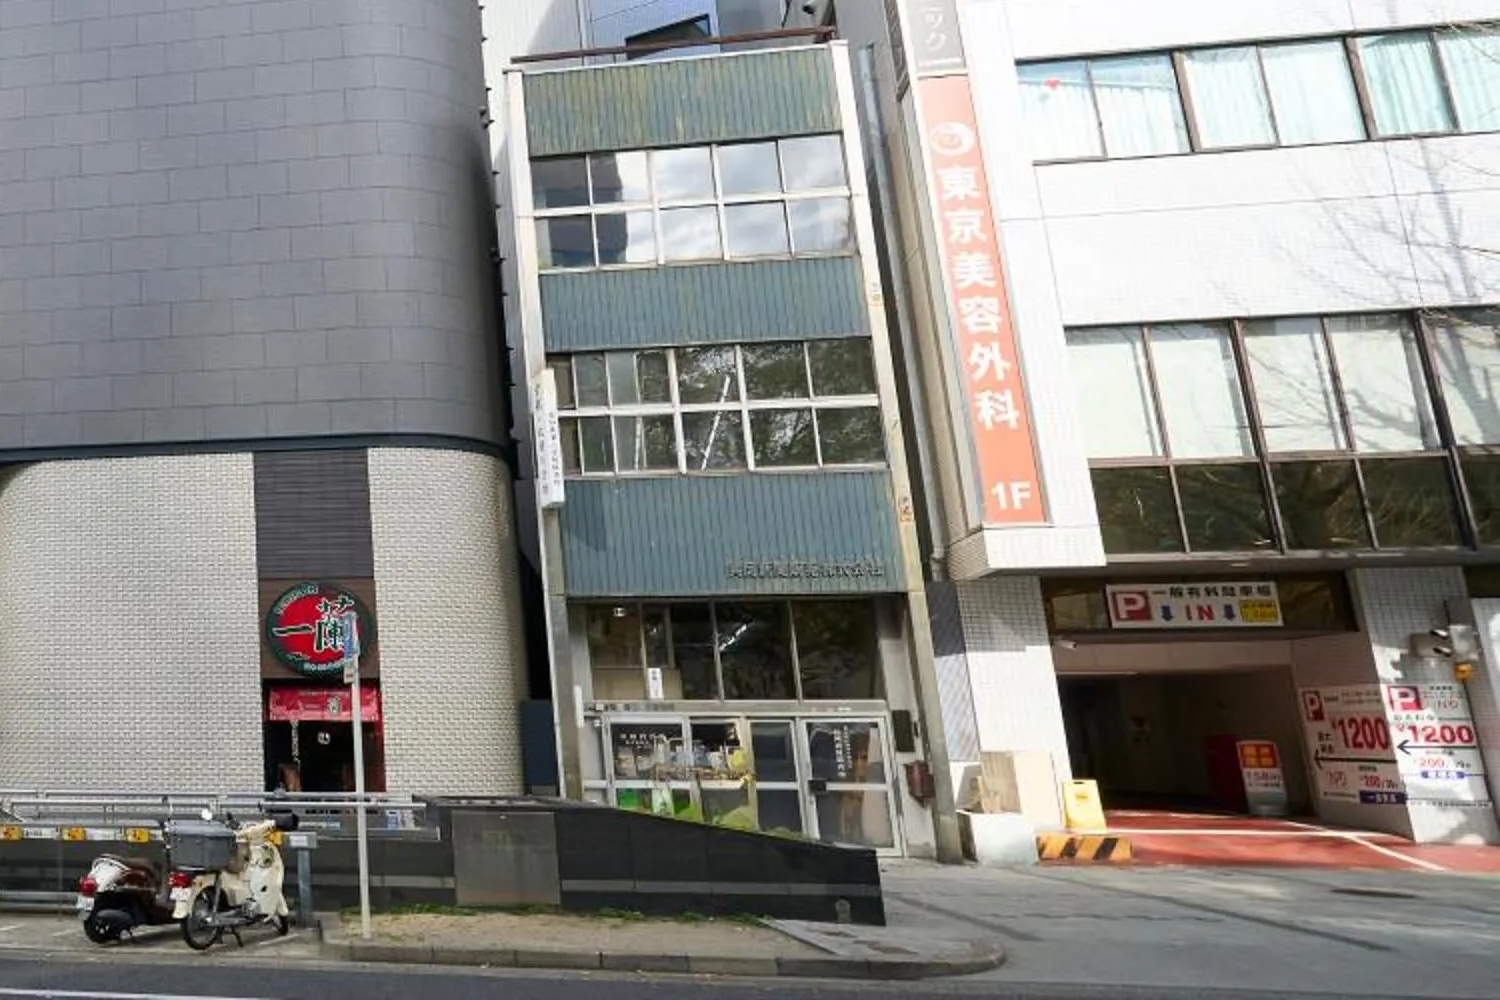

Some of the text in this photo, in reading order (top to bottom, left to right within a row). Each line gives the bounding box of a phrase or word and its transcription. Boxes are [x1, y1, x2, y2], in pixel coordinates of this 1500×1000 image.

[936, 165, 1020, 432] 東京美容外科
[991, 480, 1032, 512] 1F
[1114, 592, 1147, 620] P
[1185, 604, 1216, 621] IN
